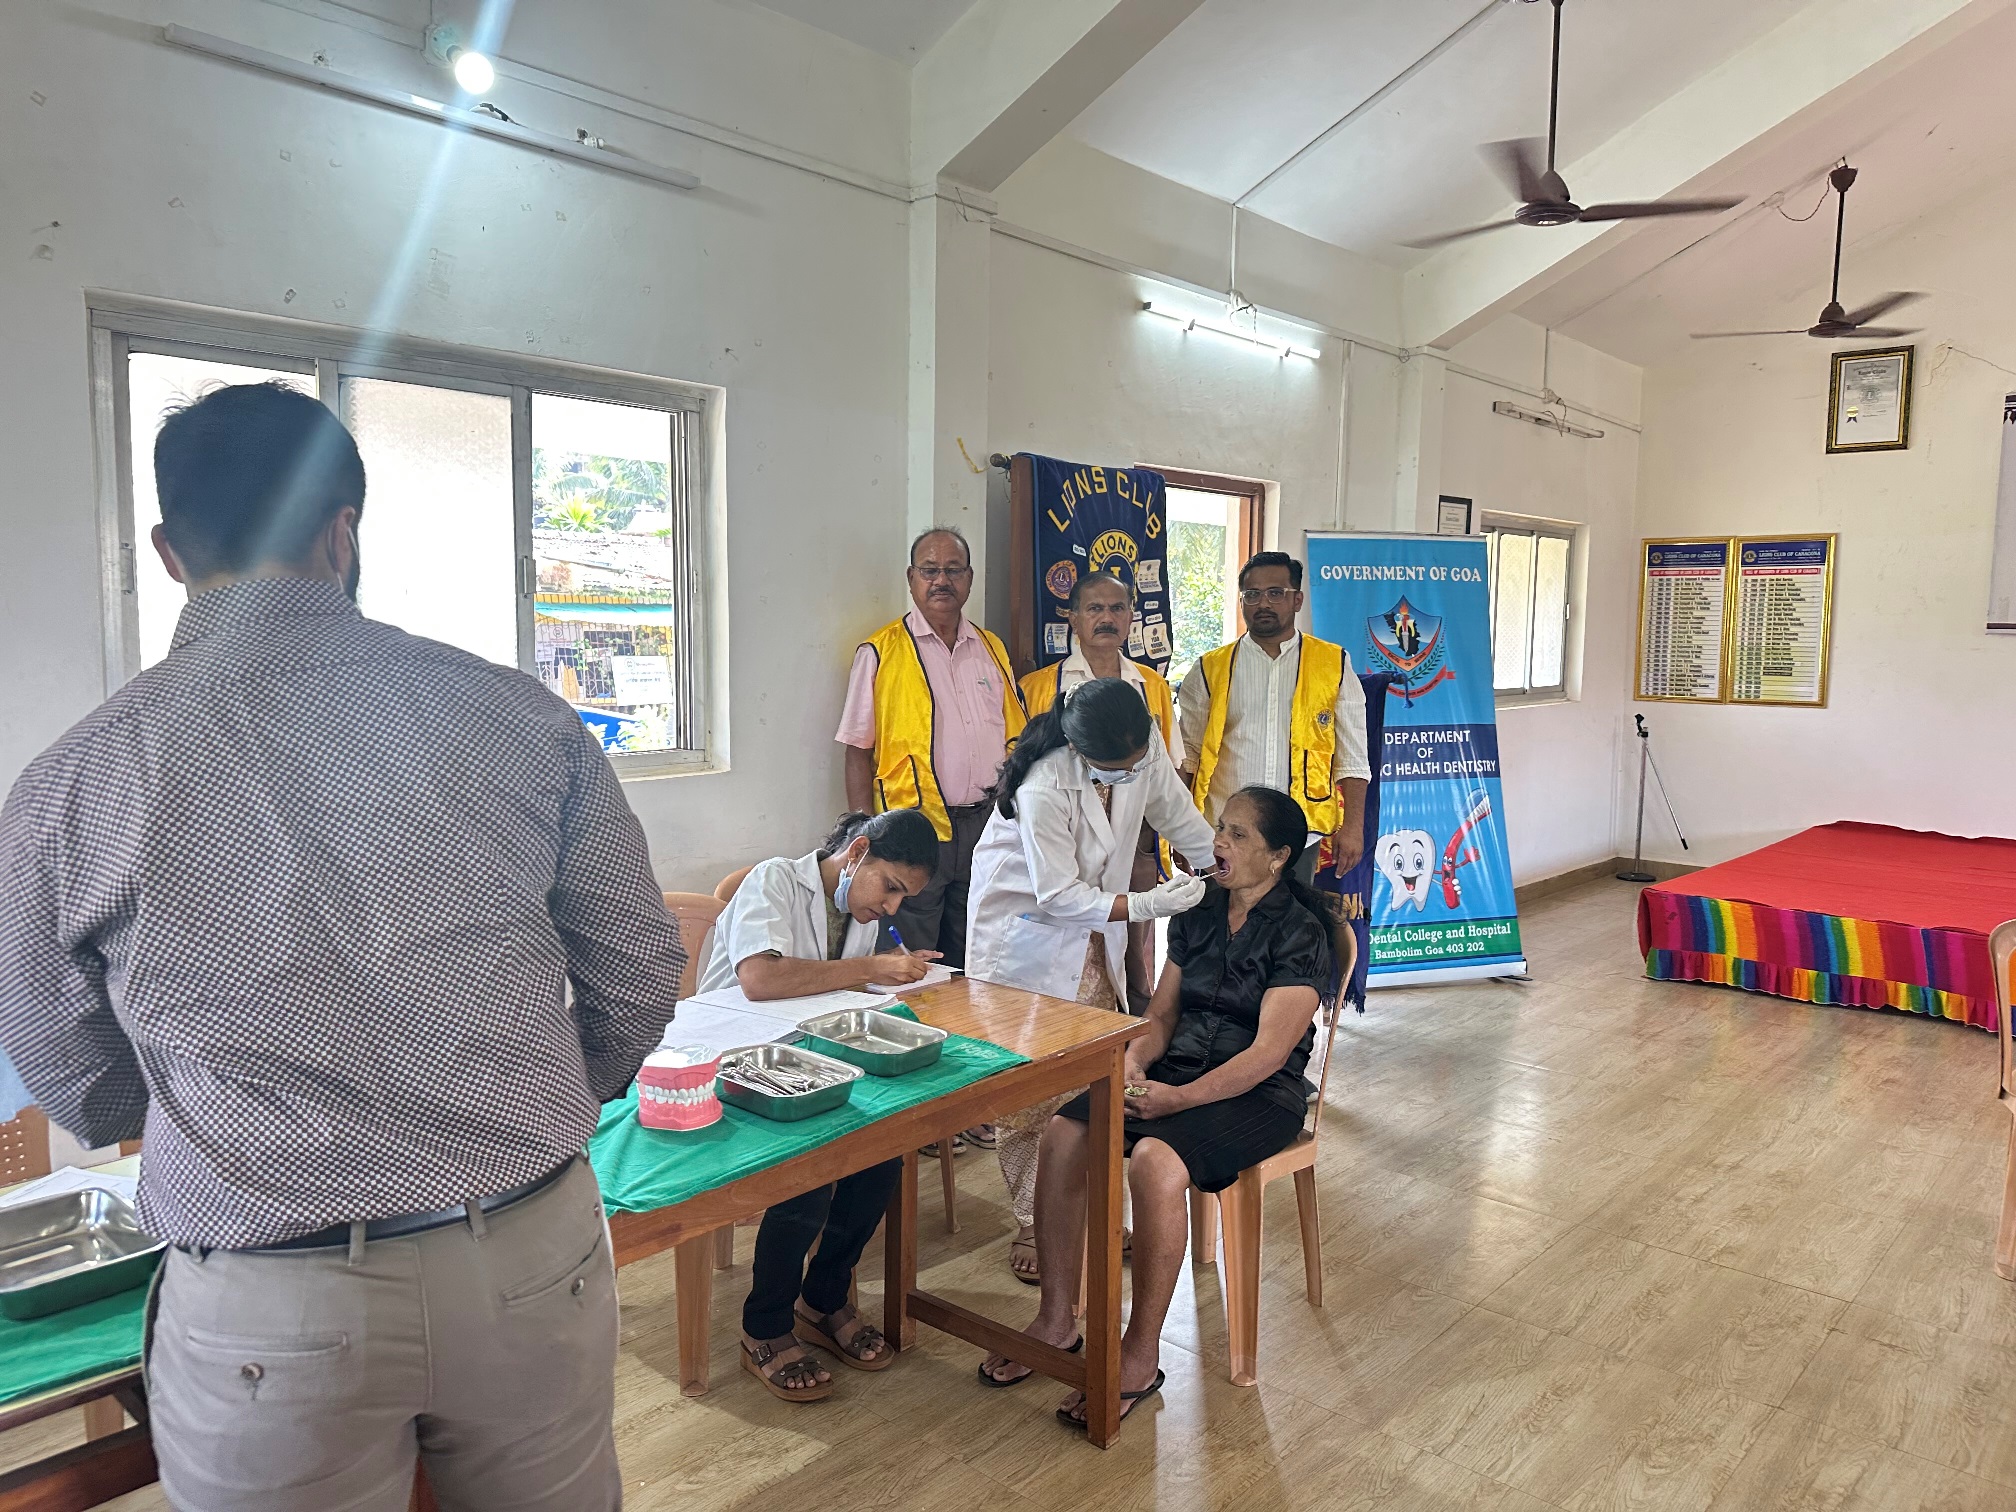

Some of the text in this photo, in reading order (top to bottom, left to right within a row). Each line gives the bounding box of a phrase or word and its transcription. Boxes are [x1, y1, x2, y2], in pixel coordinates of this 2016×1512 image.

[1046, 466, 1162, 540] LIONS CLUB
[1094, 535, 1136, 559] LIONS
[1320, 565, 1482, 583] GOVERNMENT OF GOA
[1384, 730, 1471, 745] DEPARTMENT
[1417, 747, 1434, 759] OF
[1395, 761, 1440, 776] HEALTH
[1444, 759, 1497, 775] DENTISTRY
[1404, 926, 1443, 944] College
[1445, 926, 1464, 940] and
[1468, 922, 1512, 940] Hospital
[1374, 941, 1485, 960] Bambolim Goa 403 202
